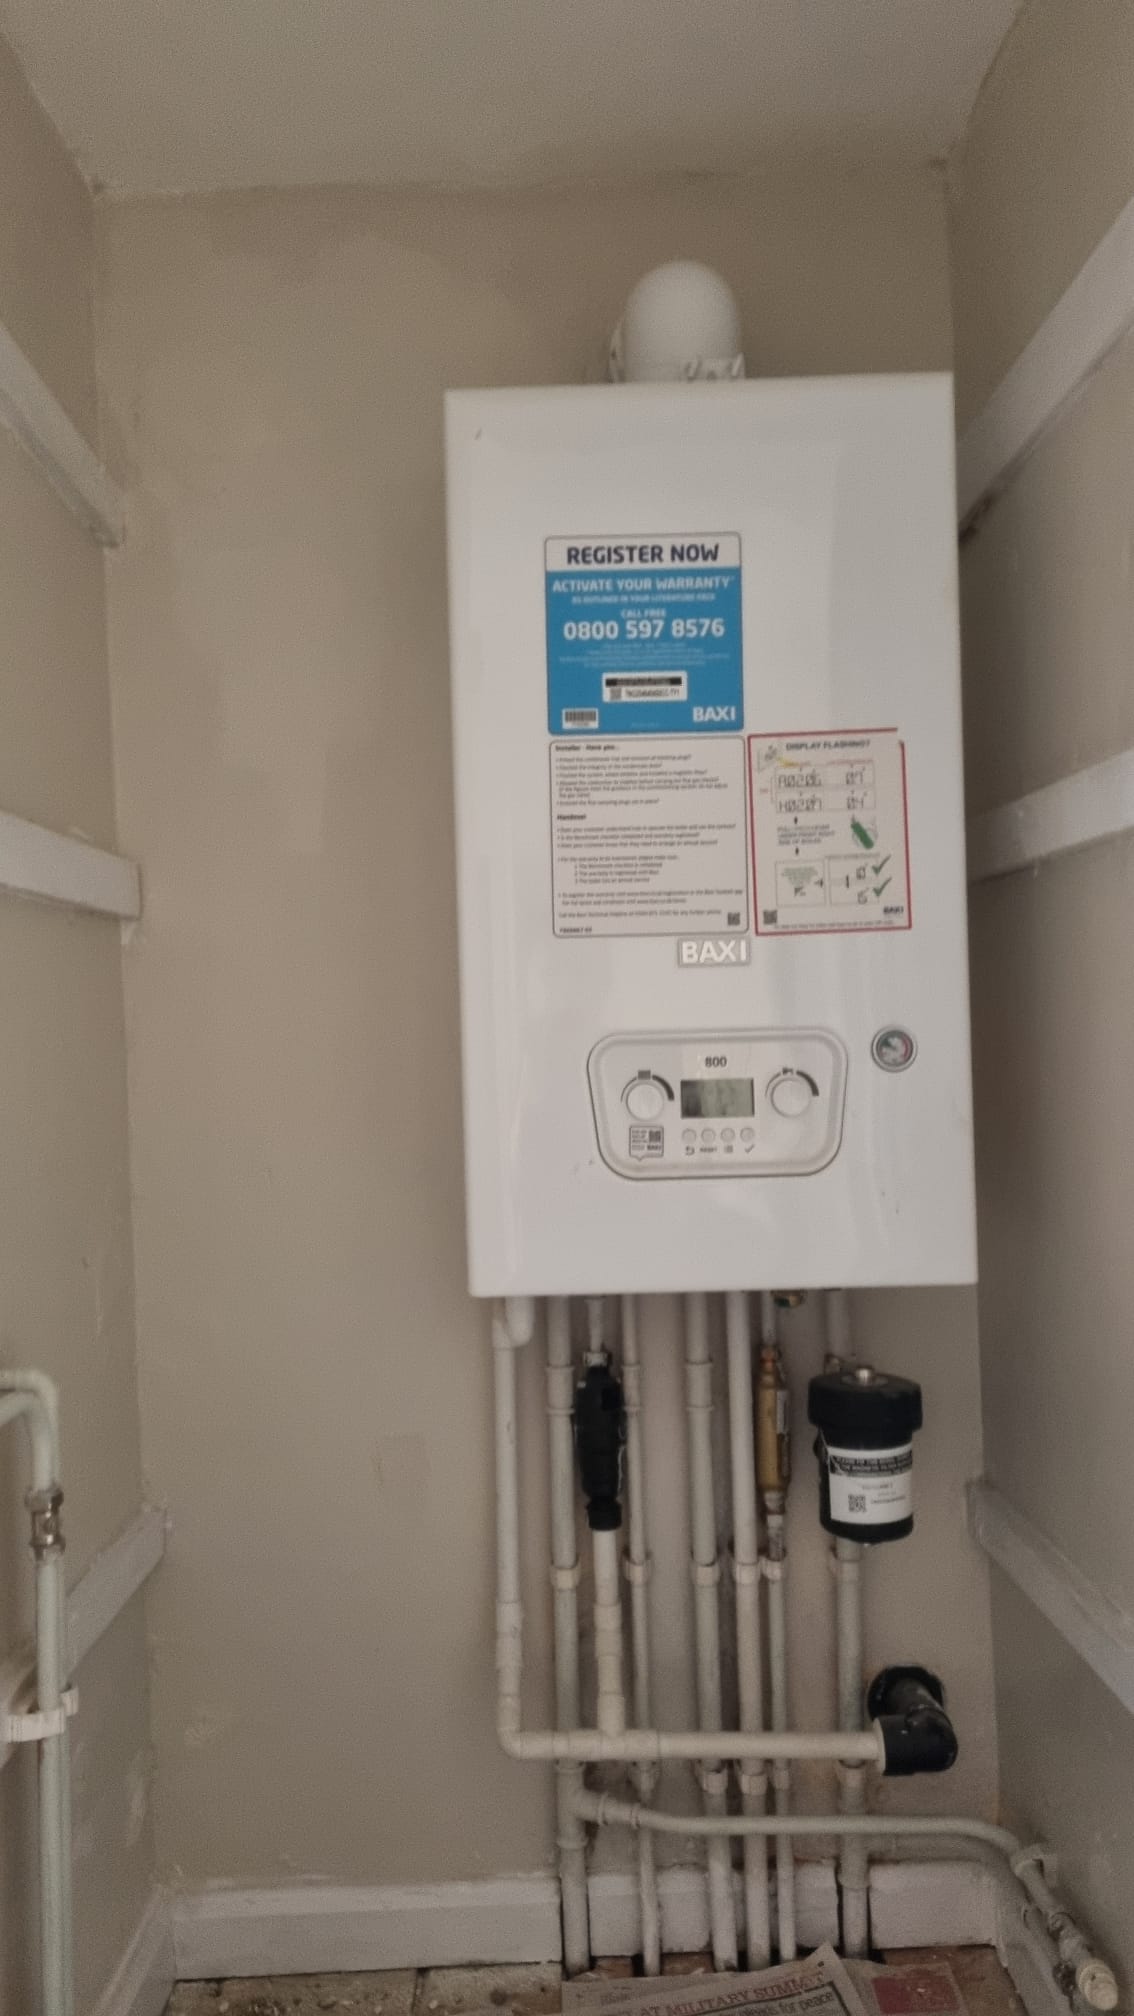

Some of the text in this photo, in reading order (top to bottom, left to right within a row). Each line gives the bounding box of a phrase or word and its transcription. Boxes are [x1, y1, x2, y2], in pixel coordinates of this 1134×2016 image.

[566, 543, 720, 565] REGISTER NOW
[552, 579, 614, 593] ACTIVATE
[617, 577, 651, 591] YOUR
[621, 608, 667, 619] CALL FREE
[563, 618, 726, 640] 0800 597 8576
[692, 706, 736, 722] BAXI
[786, 741, 821, 751] DISPLAY
[682, 940, 747, 964] BAXI
[705, 1056, 728, 1068] 800
[666, 1990, 750, 2016] MILITARY
